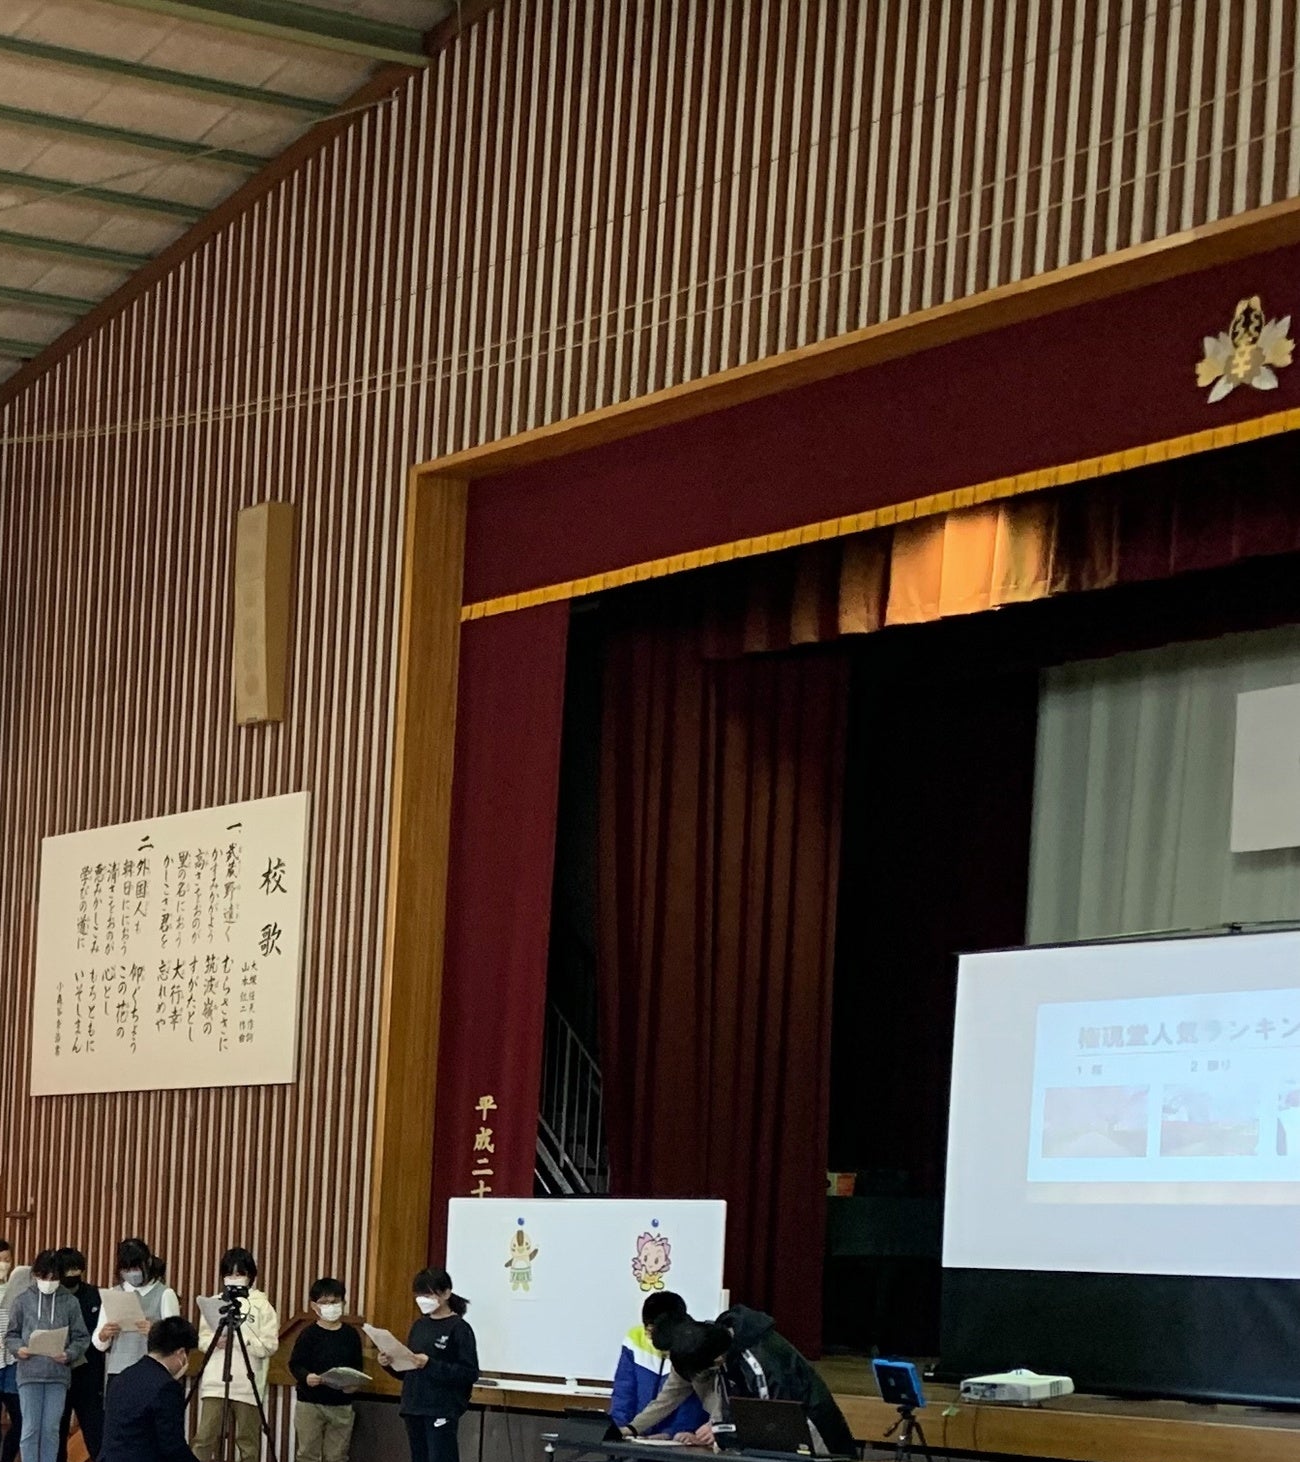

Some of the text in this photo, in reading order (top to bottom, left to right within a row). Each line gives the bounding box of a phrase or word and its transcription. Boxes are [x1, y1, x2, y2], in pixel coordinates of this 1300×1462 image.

[259, 857, 287, 957] 校歌
[470, 1094, 498, 1198] 平成二十
